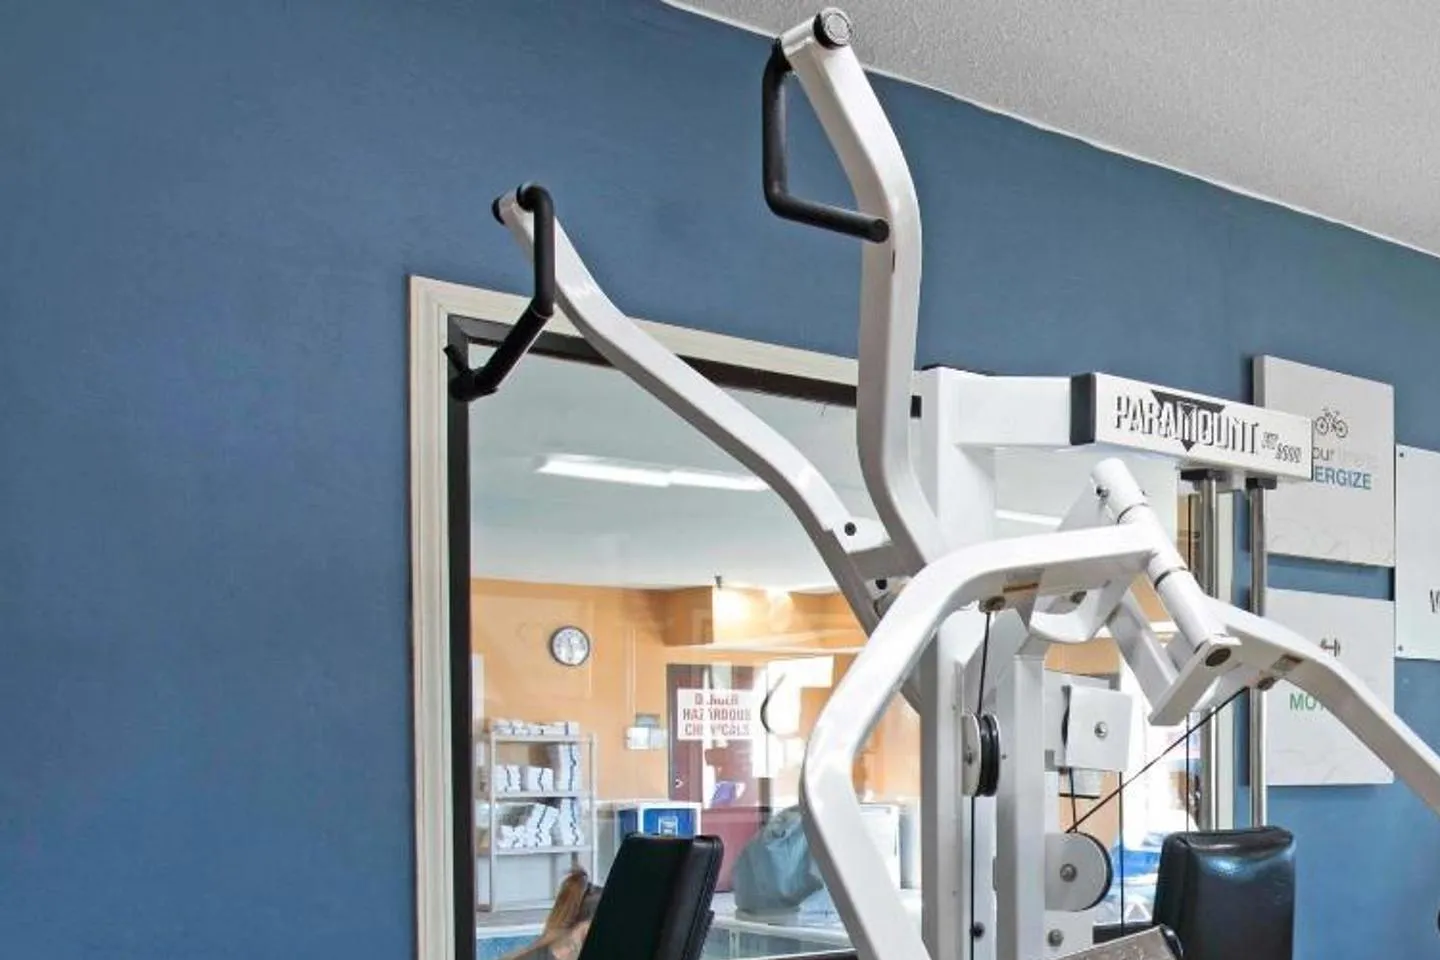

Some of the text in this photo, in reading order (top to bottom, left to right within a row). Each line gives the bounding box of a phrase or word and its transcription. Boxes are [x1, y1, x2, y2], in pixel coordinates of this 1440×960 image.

[1115, 394, 1259, 455] PARAMOUNT
[1314, 465, 1372, 490] ERGIZE
[694, 692, 739, 706] DNGER
